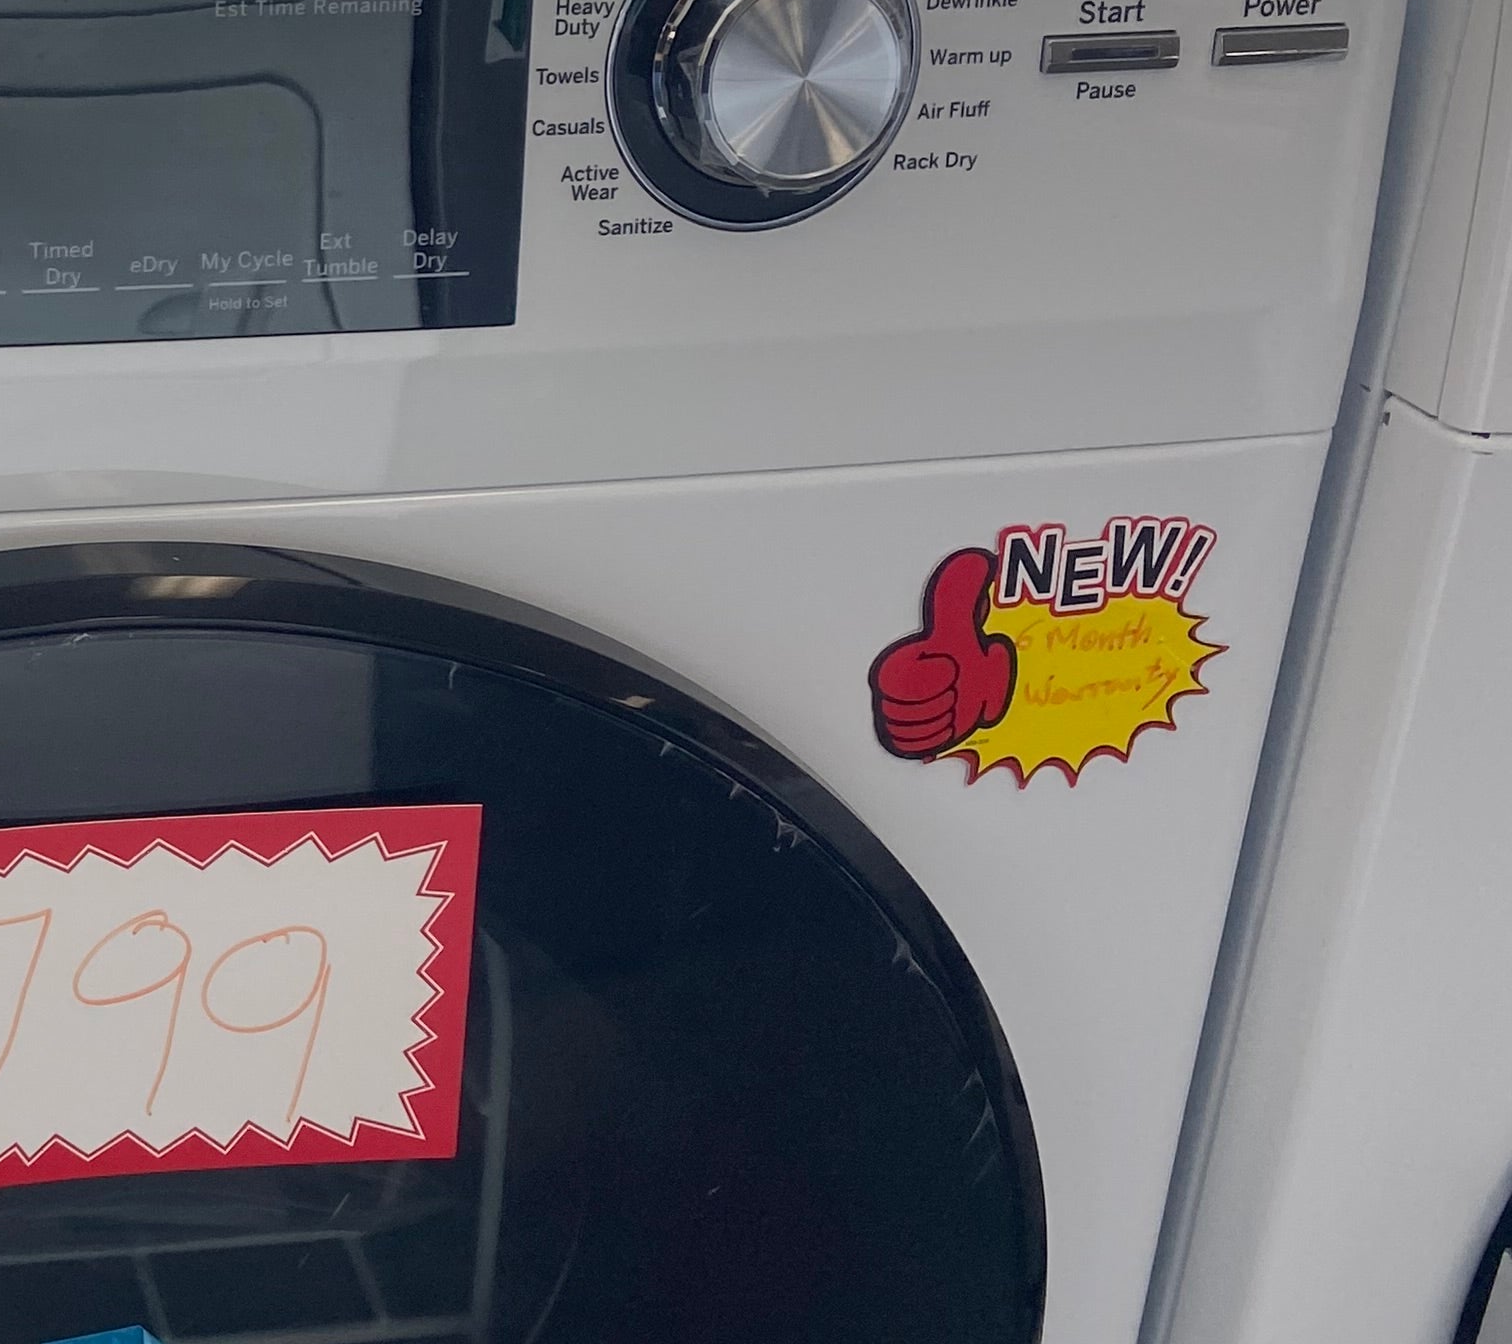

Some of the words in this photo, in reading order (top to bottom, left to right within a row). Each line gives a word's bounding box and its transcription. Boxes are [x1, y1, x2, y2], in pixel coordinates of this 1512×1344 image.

[214, 0, 248, 17] Est
[255, 0, 306, 17] Time
[1078, 0, 1146, 25] Start
[554, 18, 601, 40] Duty
[929, 48, 984, 67] Warm
[989, 49, 1013, 68] up
[536, 66, 600, 86] Towels
[1076, 81, 1137, 100] Pause
[917, 102, 945, 121] Air
[949, 100, 992, 119] Fluff
[532, 117, 606, 137] Casuals
[893, 152, 940, 172] Rack
[945, 151, 979, 172] Dry
[560, 164, 620, 183] Active
[571, 184, 619, 202] Wear
[598, 218, 674, 236] Sanitize
[319, 233, 353, 251] Ext
[402, 228, 460, 250] Delay
[28, 240, 95, 260] Timed
[129, 256, 180, 277] eDry
[201, 252, 231, 272] My
[238, 250, 294, 271] Cycle
[304, 257, 379, 277] Tumble
[412, 252, 448, 273] Dry
[45, 267, 82, 289] Dry
[208, 297, 242, 312] Hold
[246, 297, 261, 310] to
[264, 294, 288, 311] Set
[1002, 524, 1209, 608] NEW!
